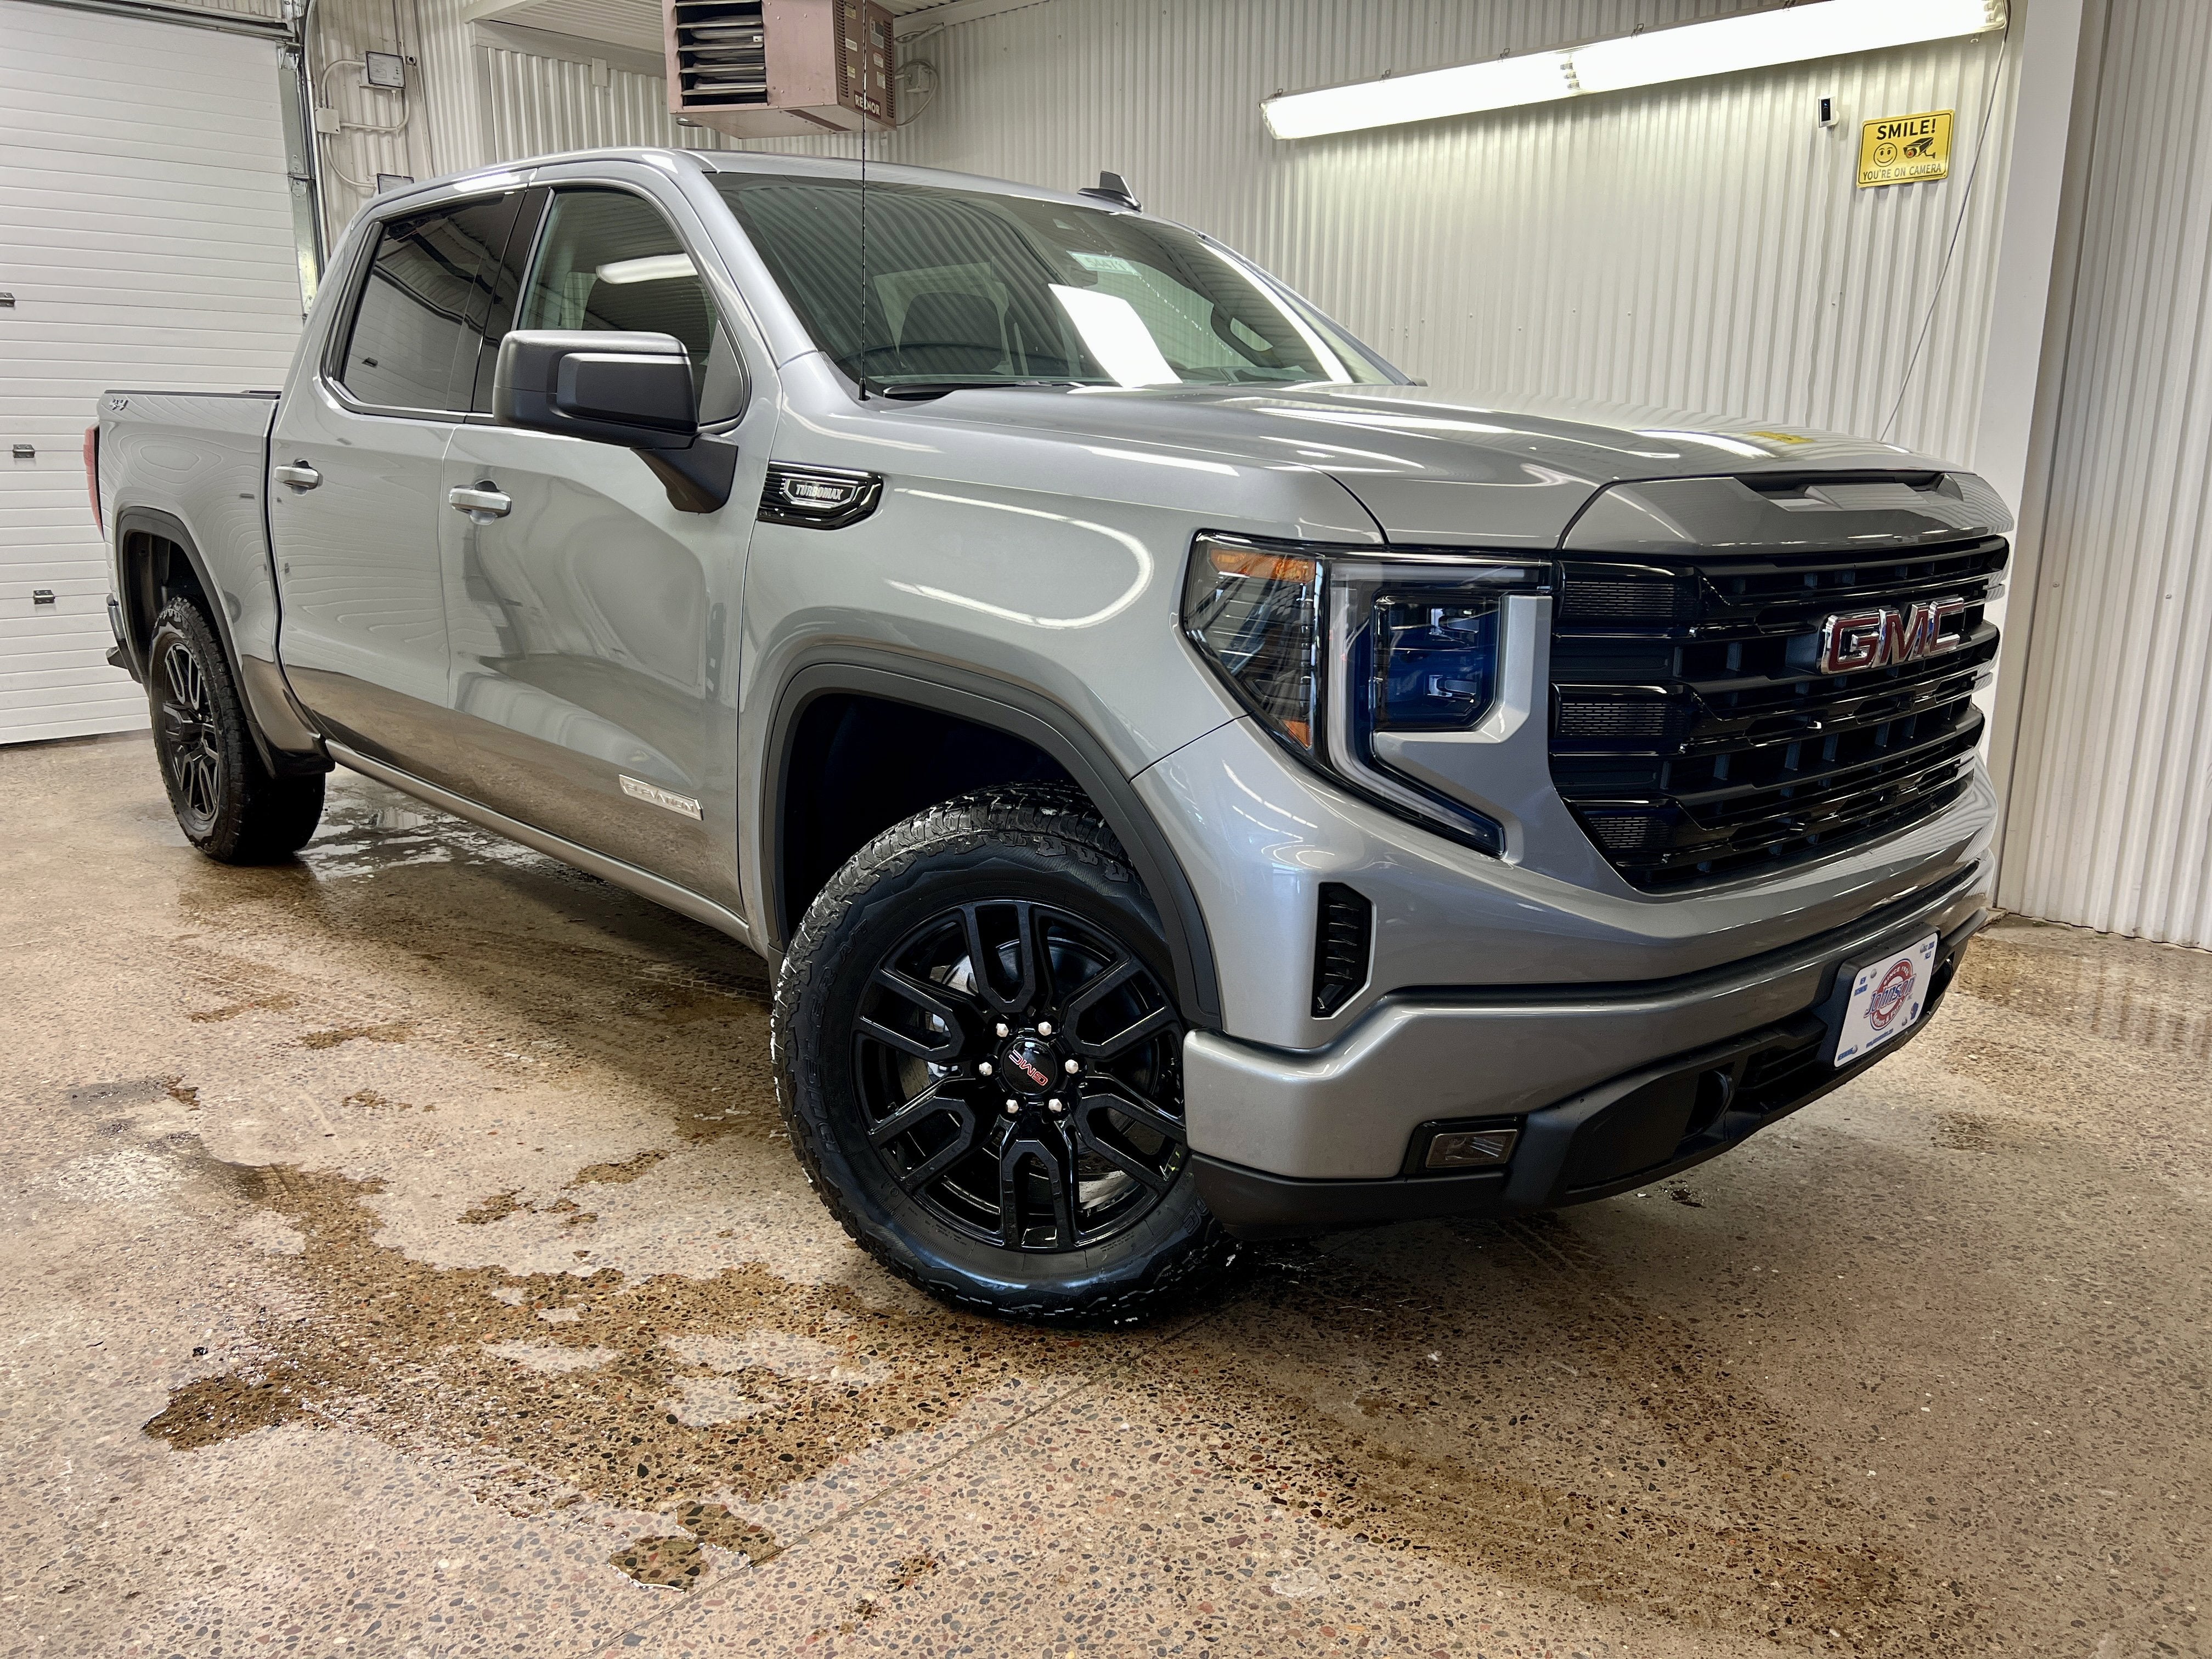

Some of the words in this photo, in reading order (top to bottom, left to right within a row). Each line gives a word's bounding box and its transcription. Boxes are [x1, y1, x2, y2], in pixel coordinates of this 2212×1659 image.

[855, 94, 881, 116] RENOR
[1876, 118, 1936, 140] SMILE!
[1863, 169, 1891, 181] YOU'RE
[1894, 167, 1906, 176] ON
[1909, 163, 1942, 176] CAMERA
[795, 484, 844, 500] TURBOMAX
[1821, 597, 1965, 675] GMC
[1883, 966, 1901, 985] SINCE
[1864, 973, 1917, 1018] Johnson
[1008, 1049, 1048, 1086] GMC
